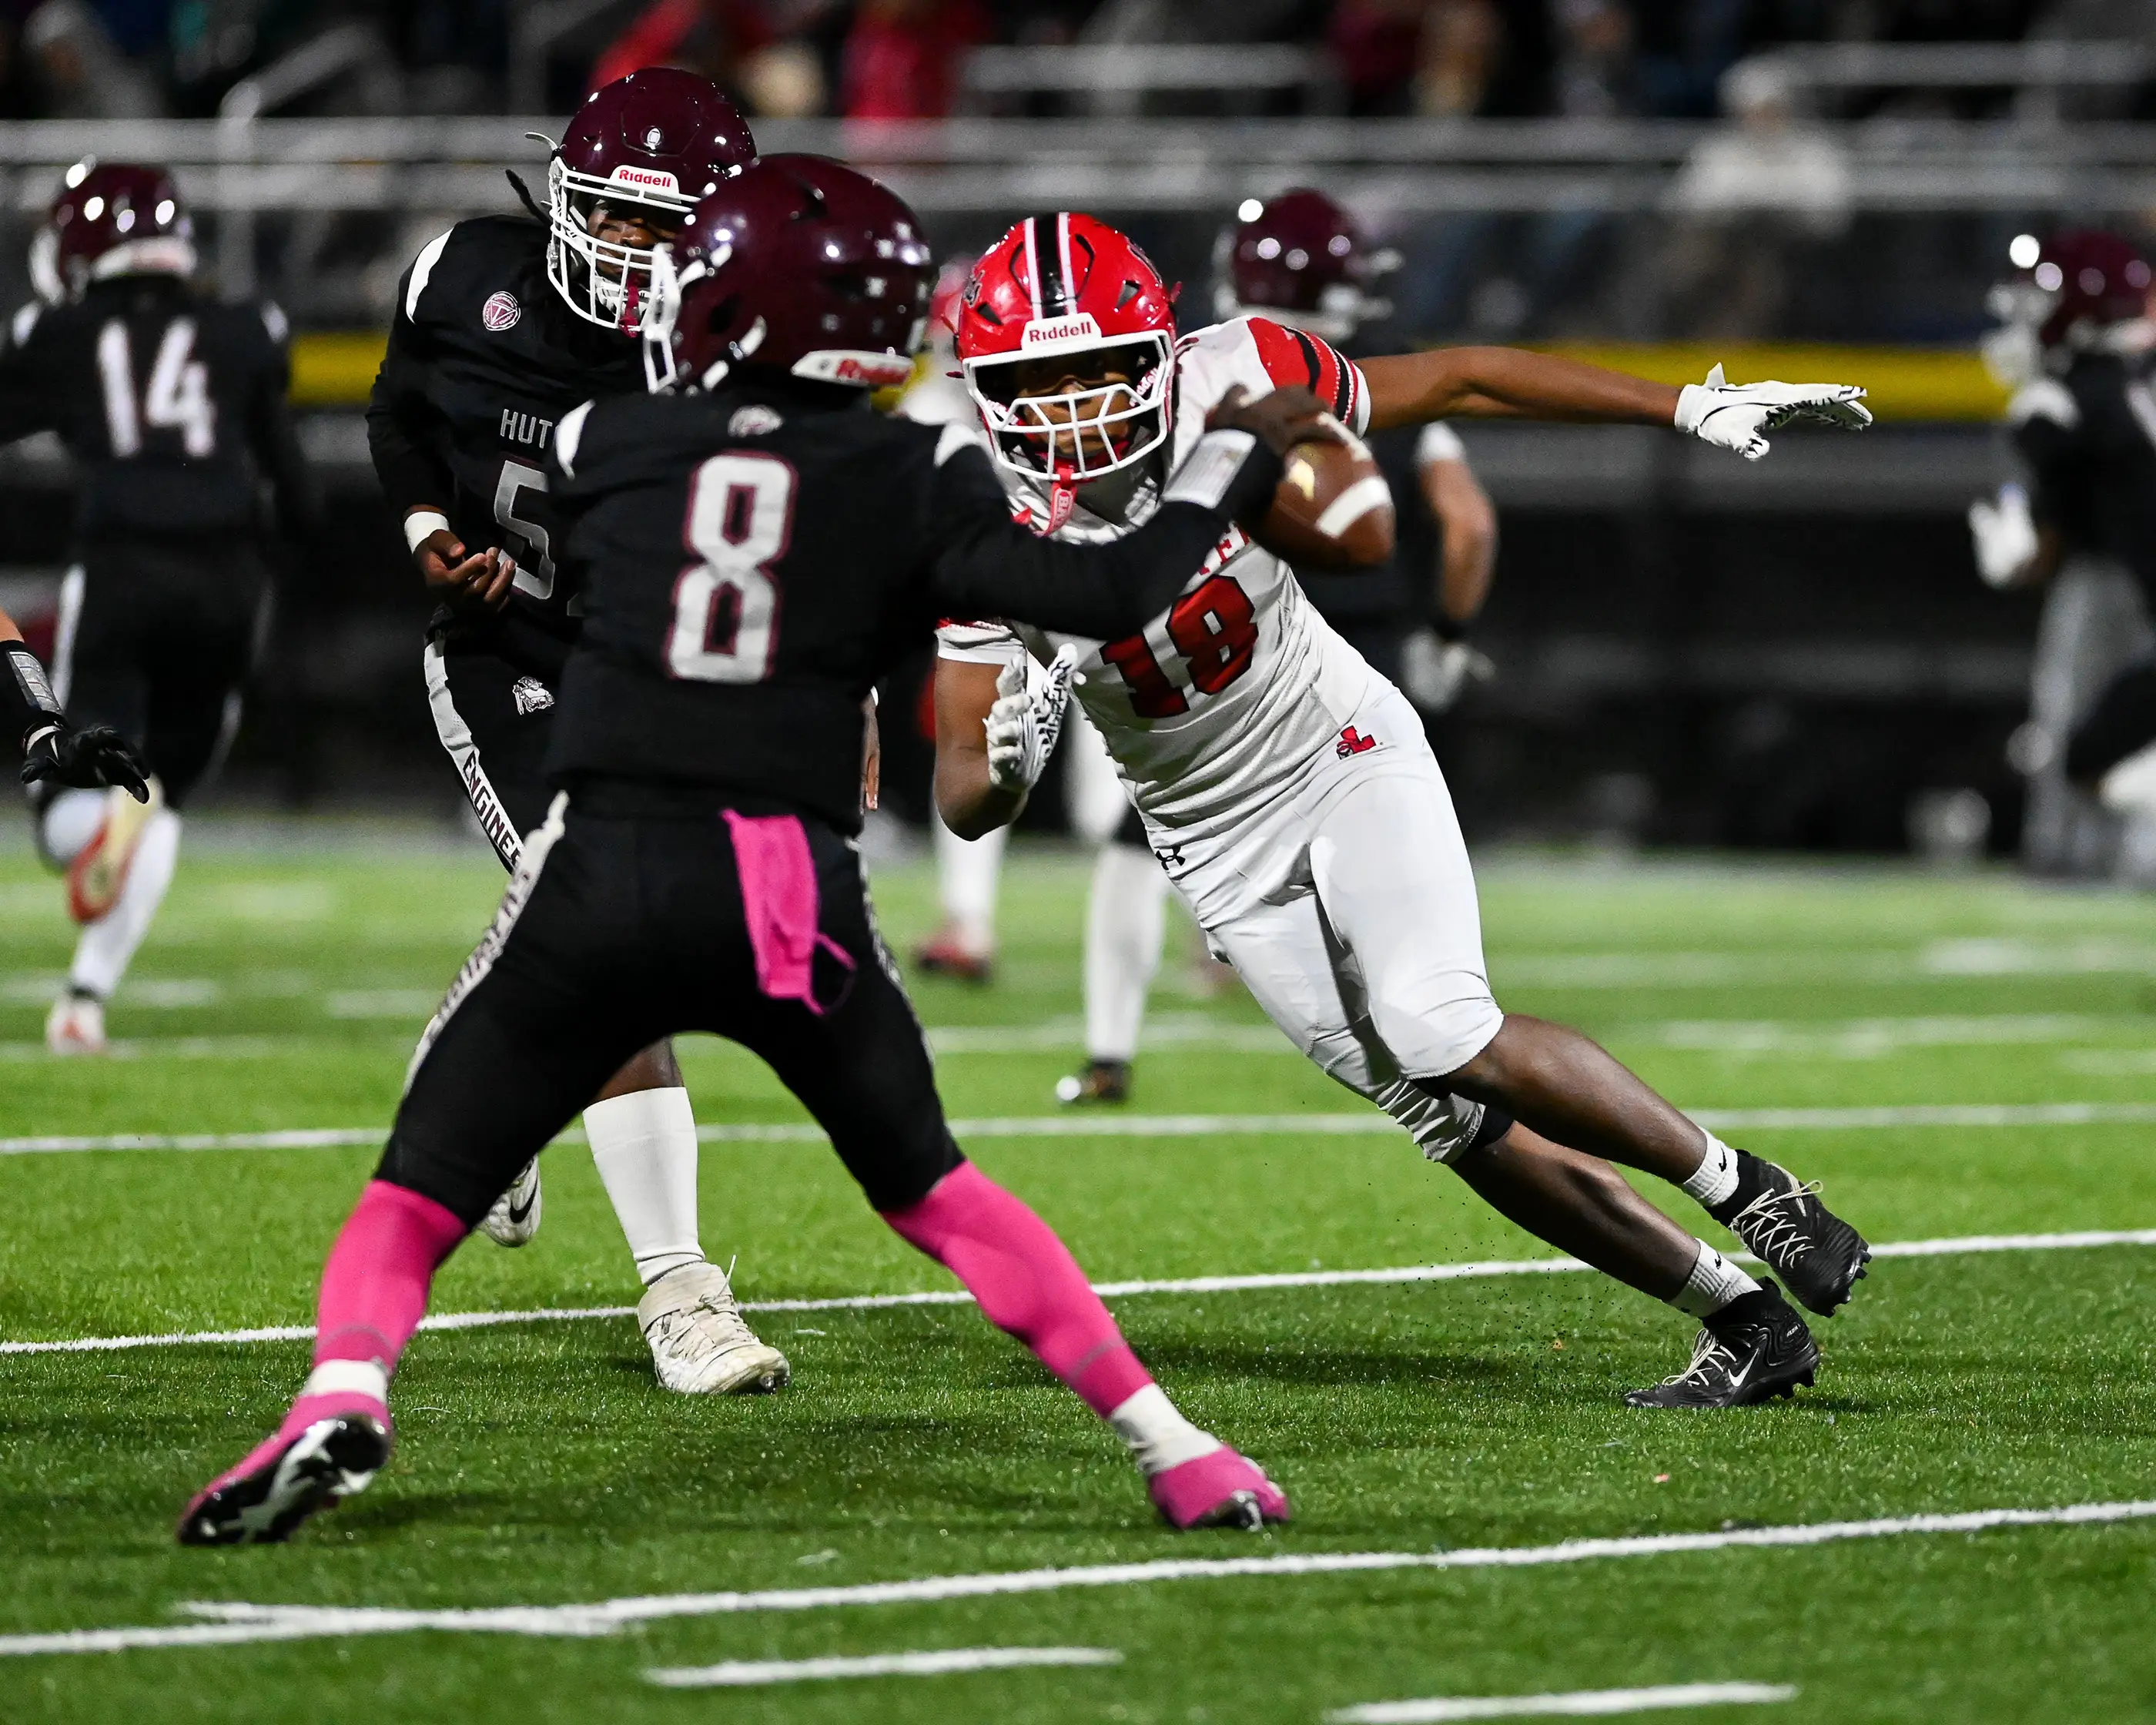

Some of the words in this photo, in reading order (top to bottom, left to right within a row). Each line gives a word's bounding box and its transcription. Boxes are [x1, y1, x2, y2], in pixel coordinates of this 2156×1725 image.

[618, 168, 671, 188] Riddell
[1028, 321, 1093, 343] Riddell
[97, 317, 217, 459] 14
[499, 408, 554, 450] HUT
[663, 449, 799, 685] 8
[1099, 574, 1260, 718] 18
